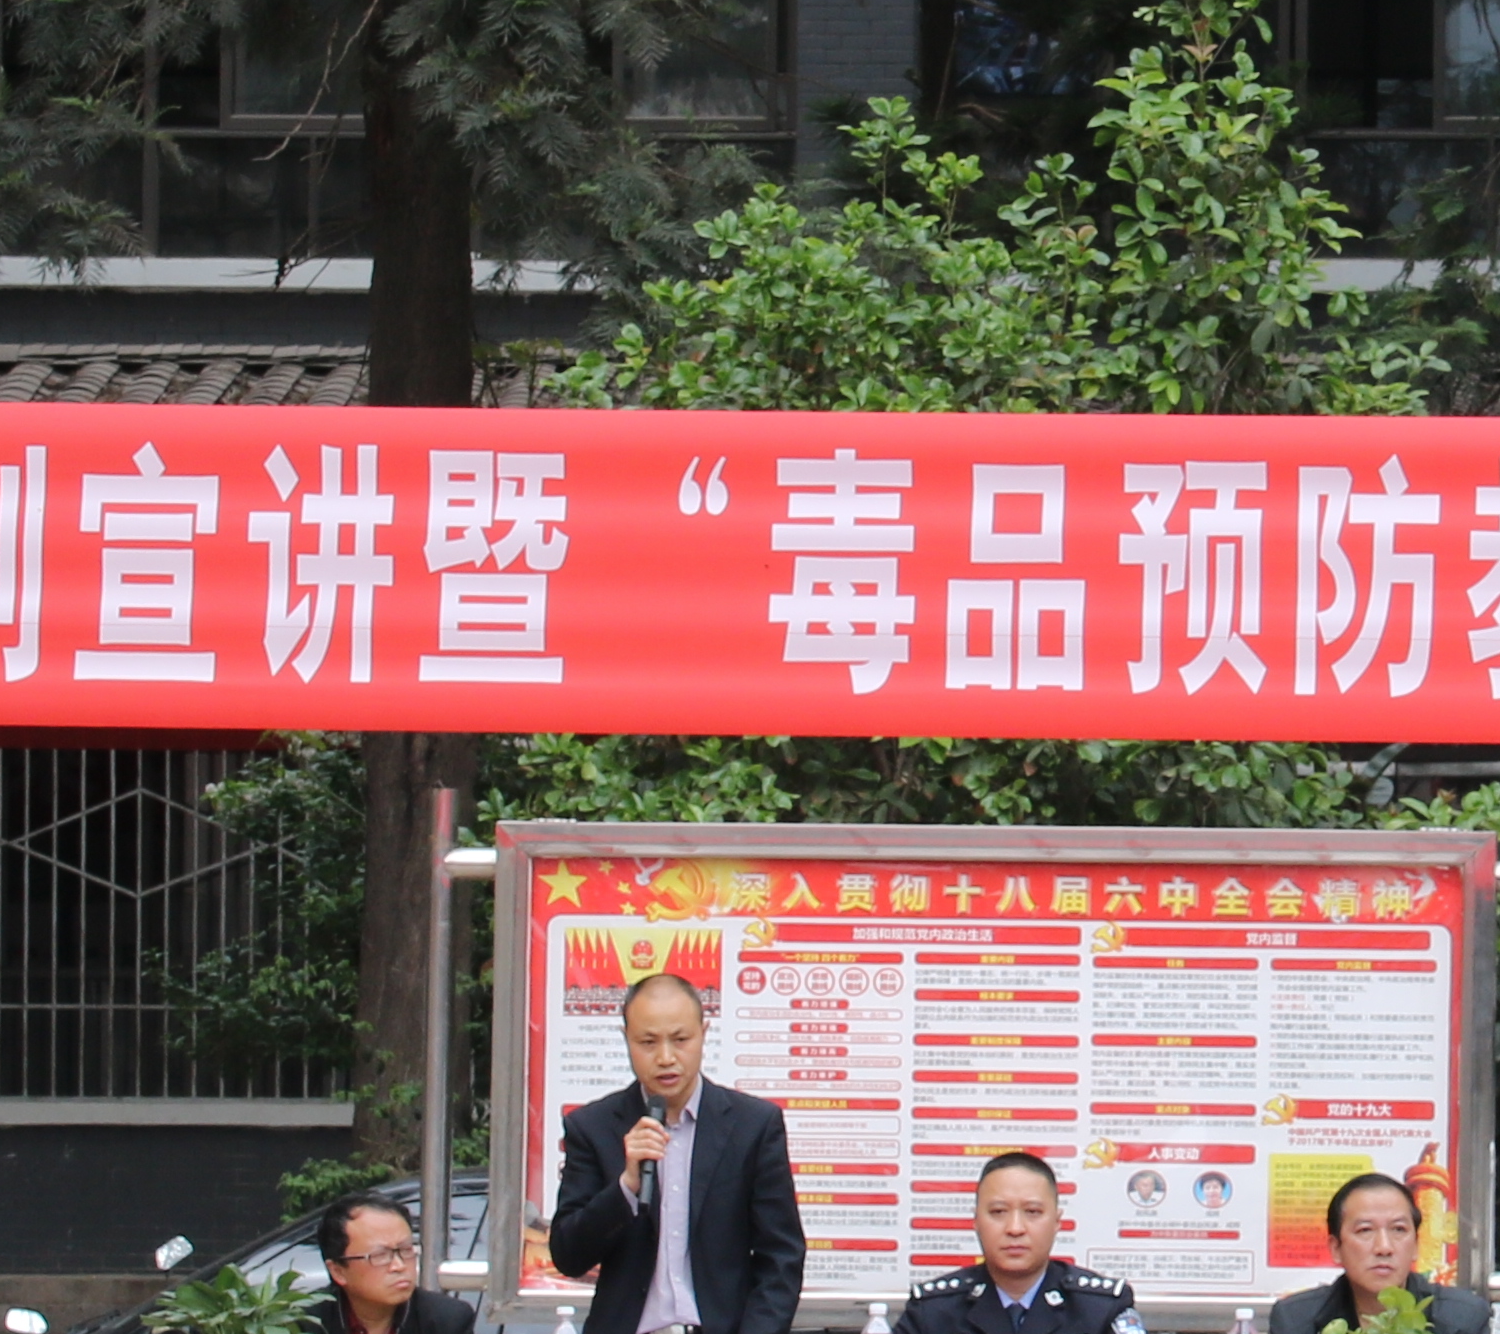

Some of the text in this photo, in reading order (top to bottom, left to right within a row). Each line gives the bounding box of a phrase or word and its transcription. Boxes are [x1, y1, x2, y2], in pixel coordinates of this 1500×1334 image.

[730, 872, 1413, 917] 深入贯彻十八届六中全会精神
[852, 927, 993, 943] 加强和规范党内政治生活
[1245, 932, 1298, 946] 党内监督
[1326, 1103, 1392, 1117] 党的十九大
[1148, 1148, 1200, 1160] 人事变动
